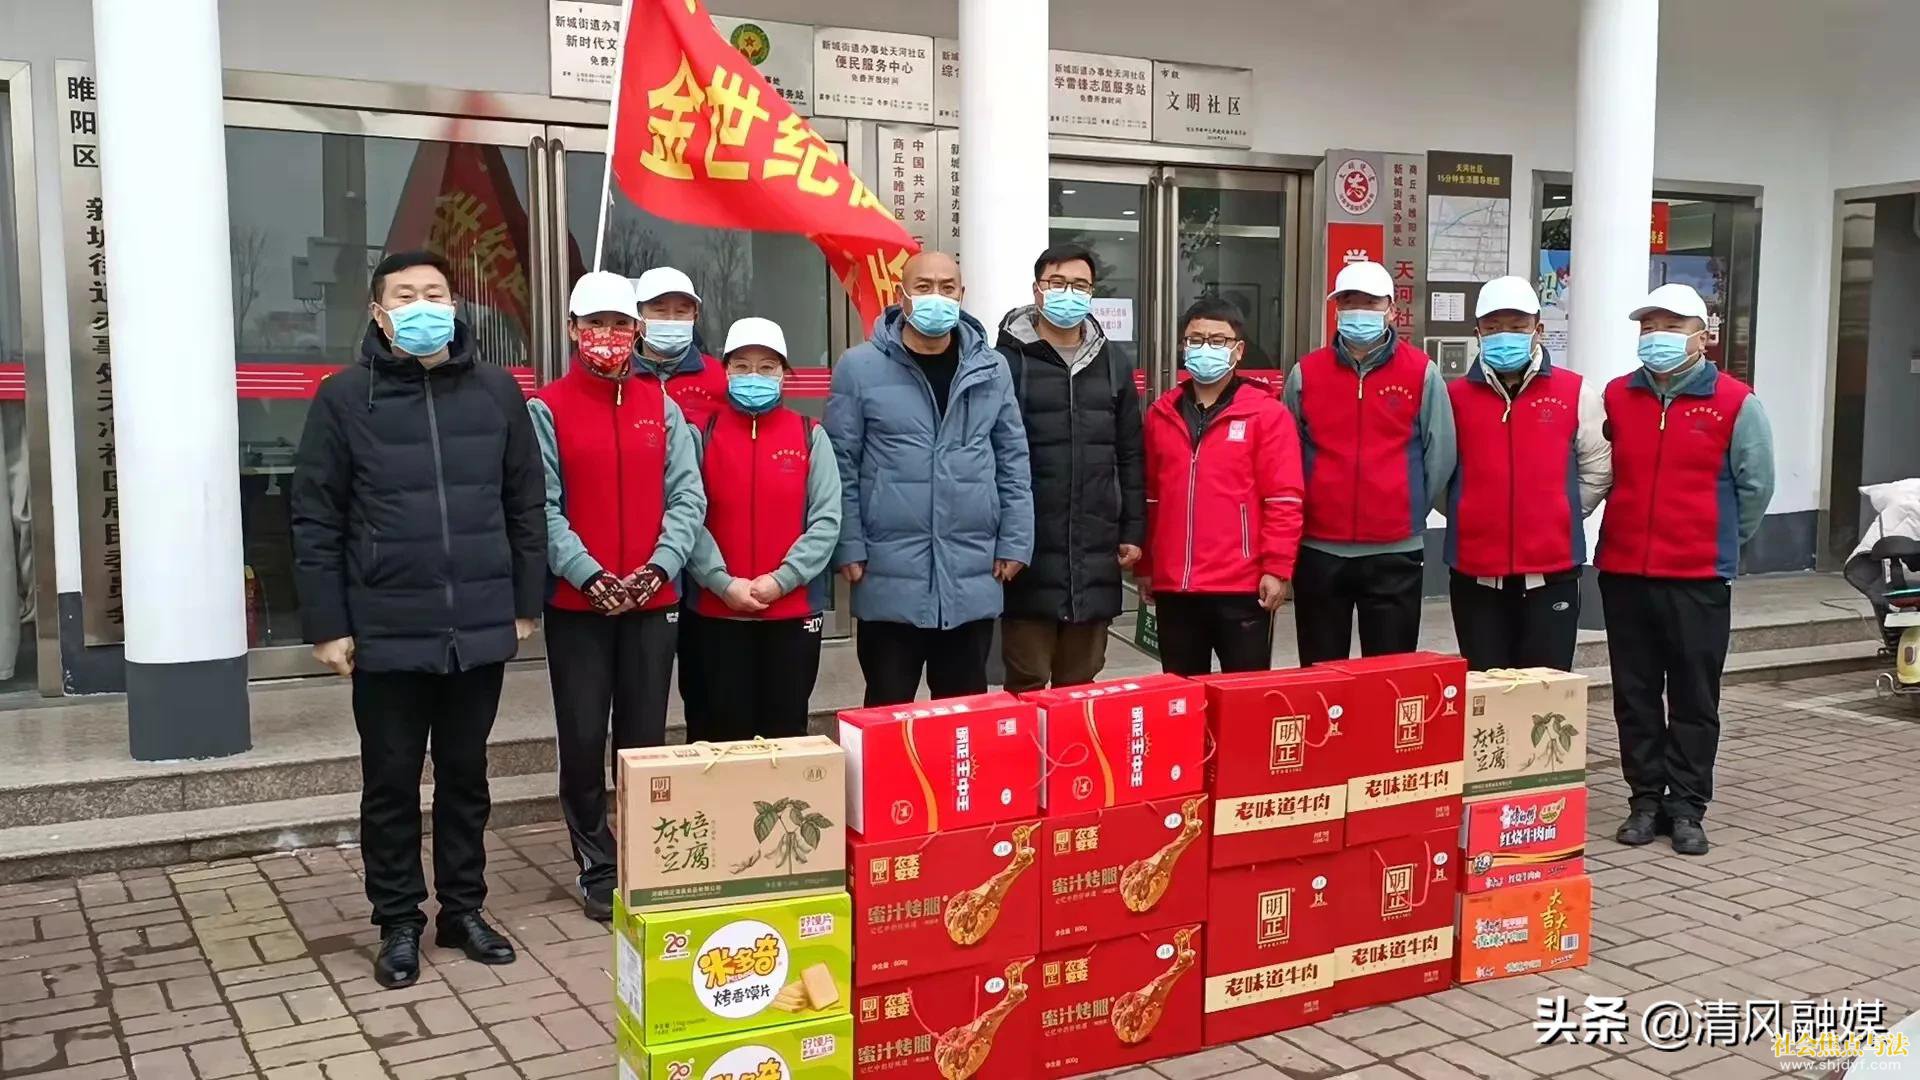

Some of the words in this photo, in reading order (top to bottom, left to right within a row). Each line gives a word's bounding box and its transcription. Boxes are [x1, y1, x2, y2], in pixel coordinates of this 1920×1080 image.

[566, 34, 617, 50] 新时代文
[822, 40, 926, 59] 新城街道办事处天河社区
[835, 55, 914, 74] 便民服务中心
[1055, 63, 1146, 80] 新城街道办事处天河社区
[1054, 76, 1146, 95] 学雷锋志愿服务站
[1166, 90, 1241, 116] 文明社区
[68, 76, 98, 168] 睢阳区
[892, 138, 905, 220] 商丘市睢阳区
[912, 139, 926, 222] 中国共产党
[1130, 706, 1145, 788] 明正王中王
[955, 725, 970, 812] 明正王中王
[1365, 769, 1449, 798] 老味道牛肉
[1235, 792, 1330, 821] 老味道牛肉
[1052, 866, 1118, 895] 蜜汁烤腿
[868, 896, 940, 925] 蜜汁烤腿
[698, 934, 780, 989] 米多奇
[1352, 934, 1439, 966] 老味道牛肉
[1225, 963, 1318, 997] 老味道牛肉
[713, 984, 771, 1007] 烤香馍片
[1042, 998, 1109, 1029] 蜜汁烤腿
[858, 1034, 932, 1065] 蜜汁烤腿
